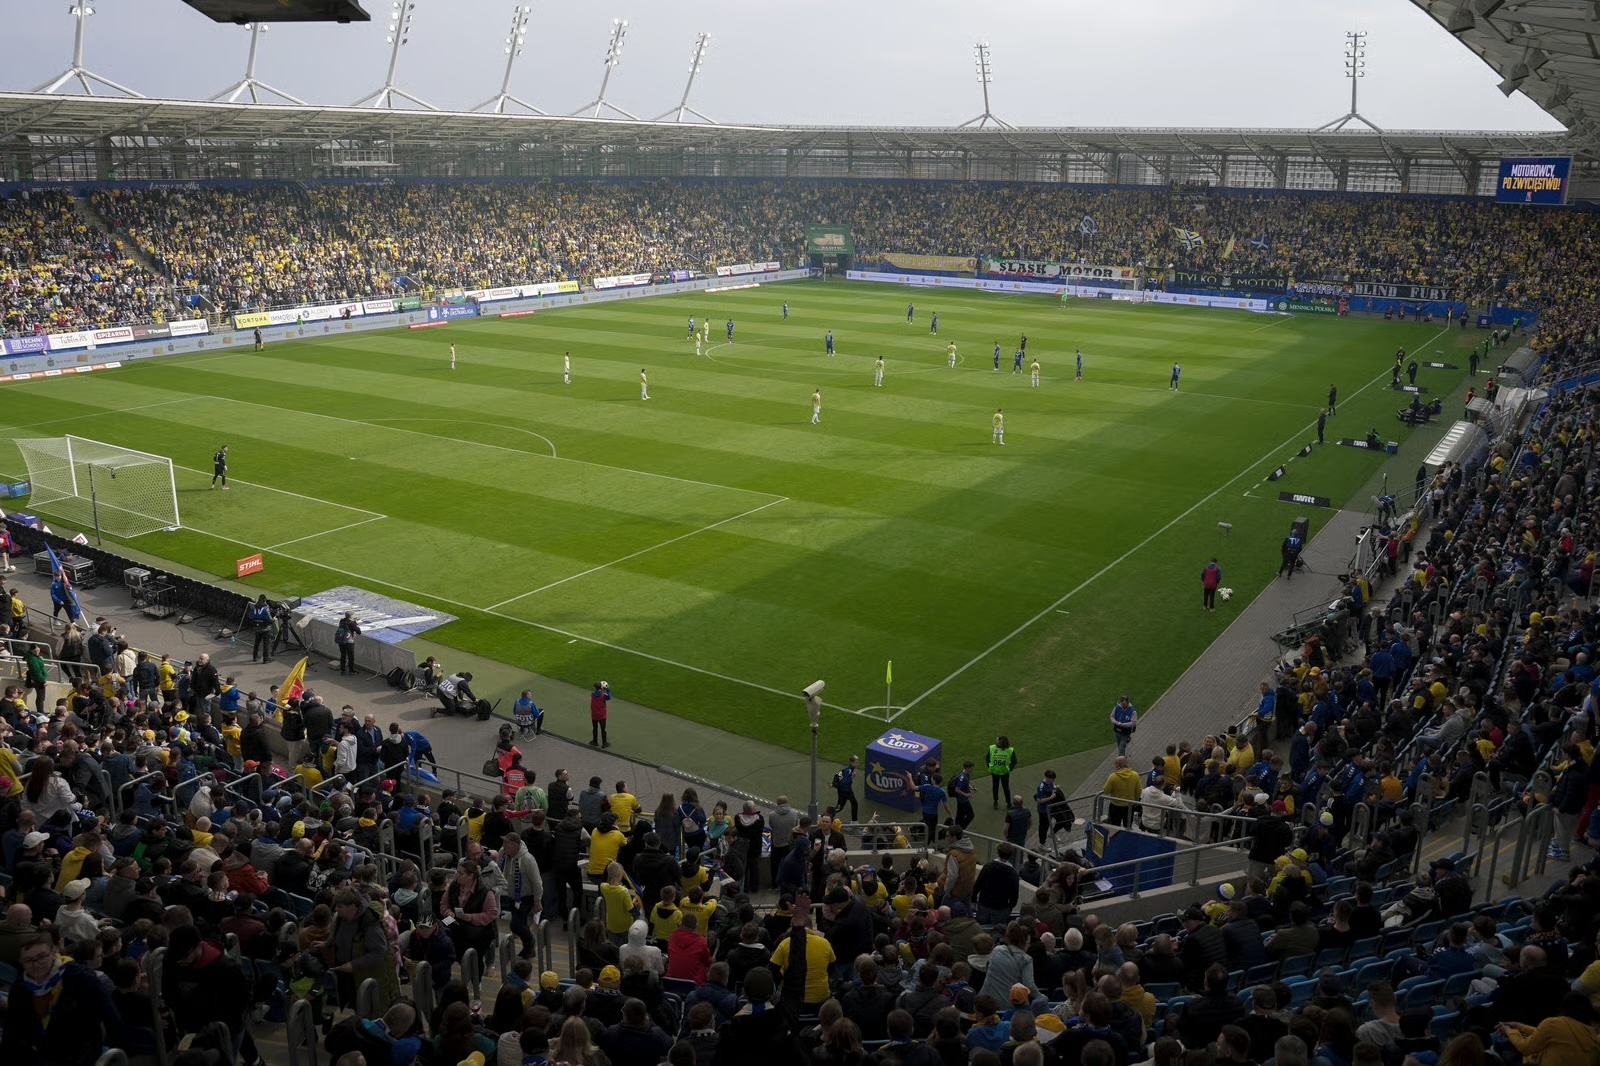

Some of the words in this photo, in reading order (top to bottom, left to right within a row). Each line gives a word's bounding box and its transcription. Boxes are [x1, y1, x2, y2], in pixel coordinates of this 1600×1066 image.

[1511, 164, 1556, 178] MOTOROWCY,
[1502, 177, 1512, 189] PO
[1512, 177, 1562, 192] ZWYCIĘSTWO!
[1058, 266, 1113, 278] MOTOR
[1177, 272, 1217, 284] TYLKO
[1236, 278, 1284, 290] MOTOR
[1355, 284, 1398, 297] BLIND
[1410, 286, 1450, 300] FURY
[1290, 304, 1314, 312] MENNICA
[240, 559, 262, 570] STIHL
[888, 738, 919, 750] LOTTO
[875, 773, 903, 788] LOTTO
